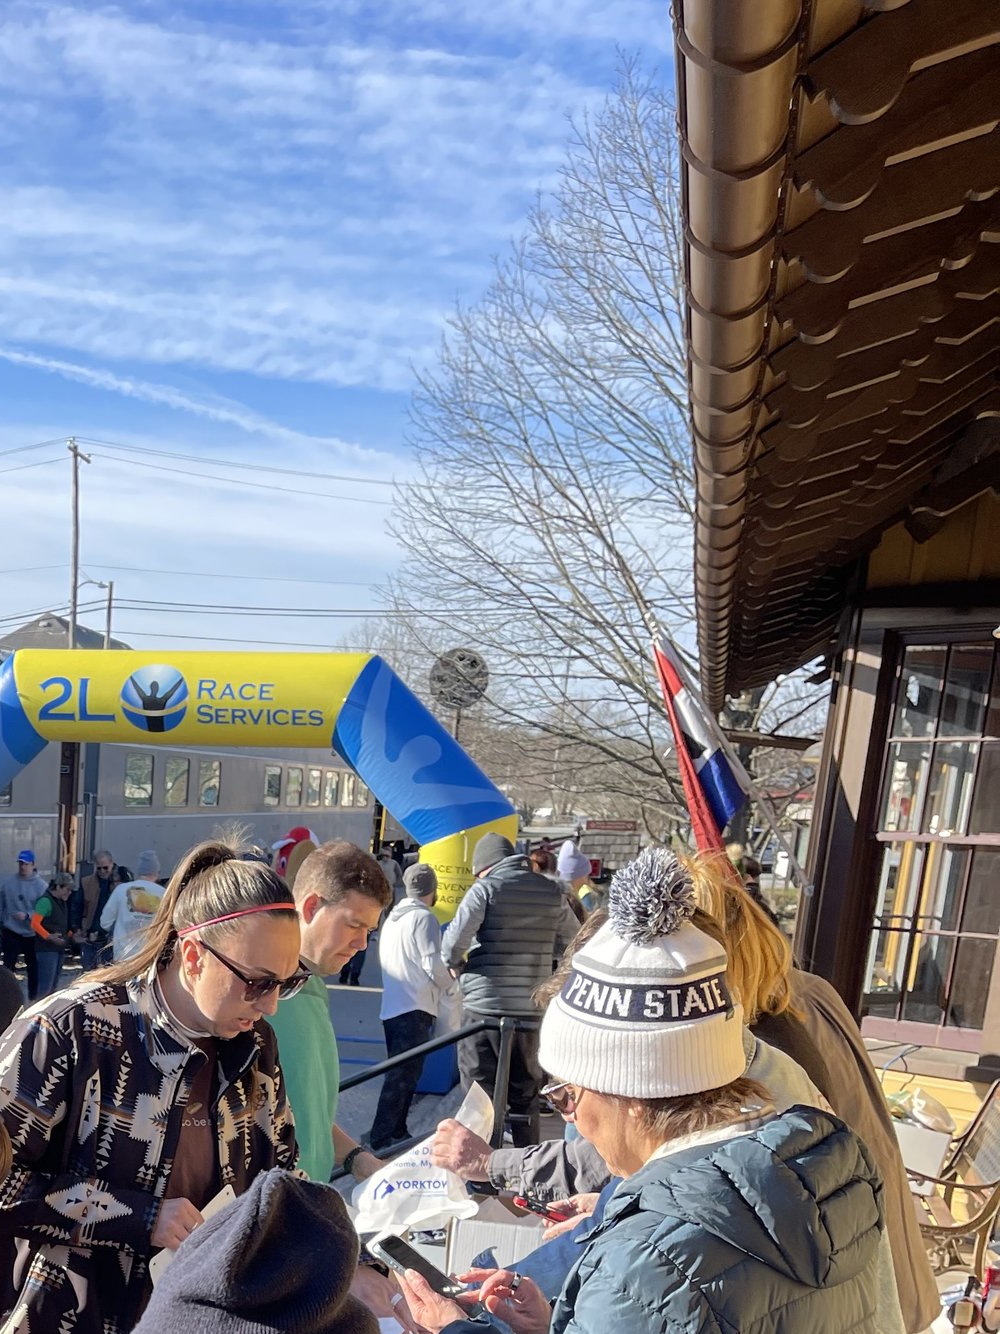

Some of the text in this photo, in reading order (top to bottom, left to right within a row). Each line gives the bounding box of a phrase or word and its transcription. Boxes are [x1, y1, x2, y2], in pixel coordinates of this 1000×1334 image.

[38, 676, 116, 722] 2L
[196, 679, 275, 701] RACE
[196, 704, 324, 726] SERVICES
[565, 973, 726, 1018] PENN STATE
